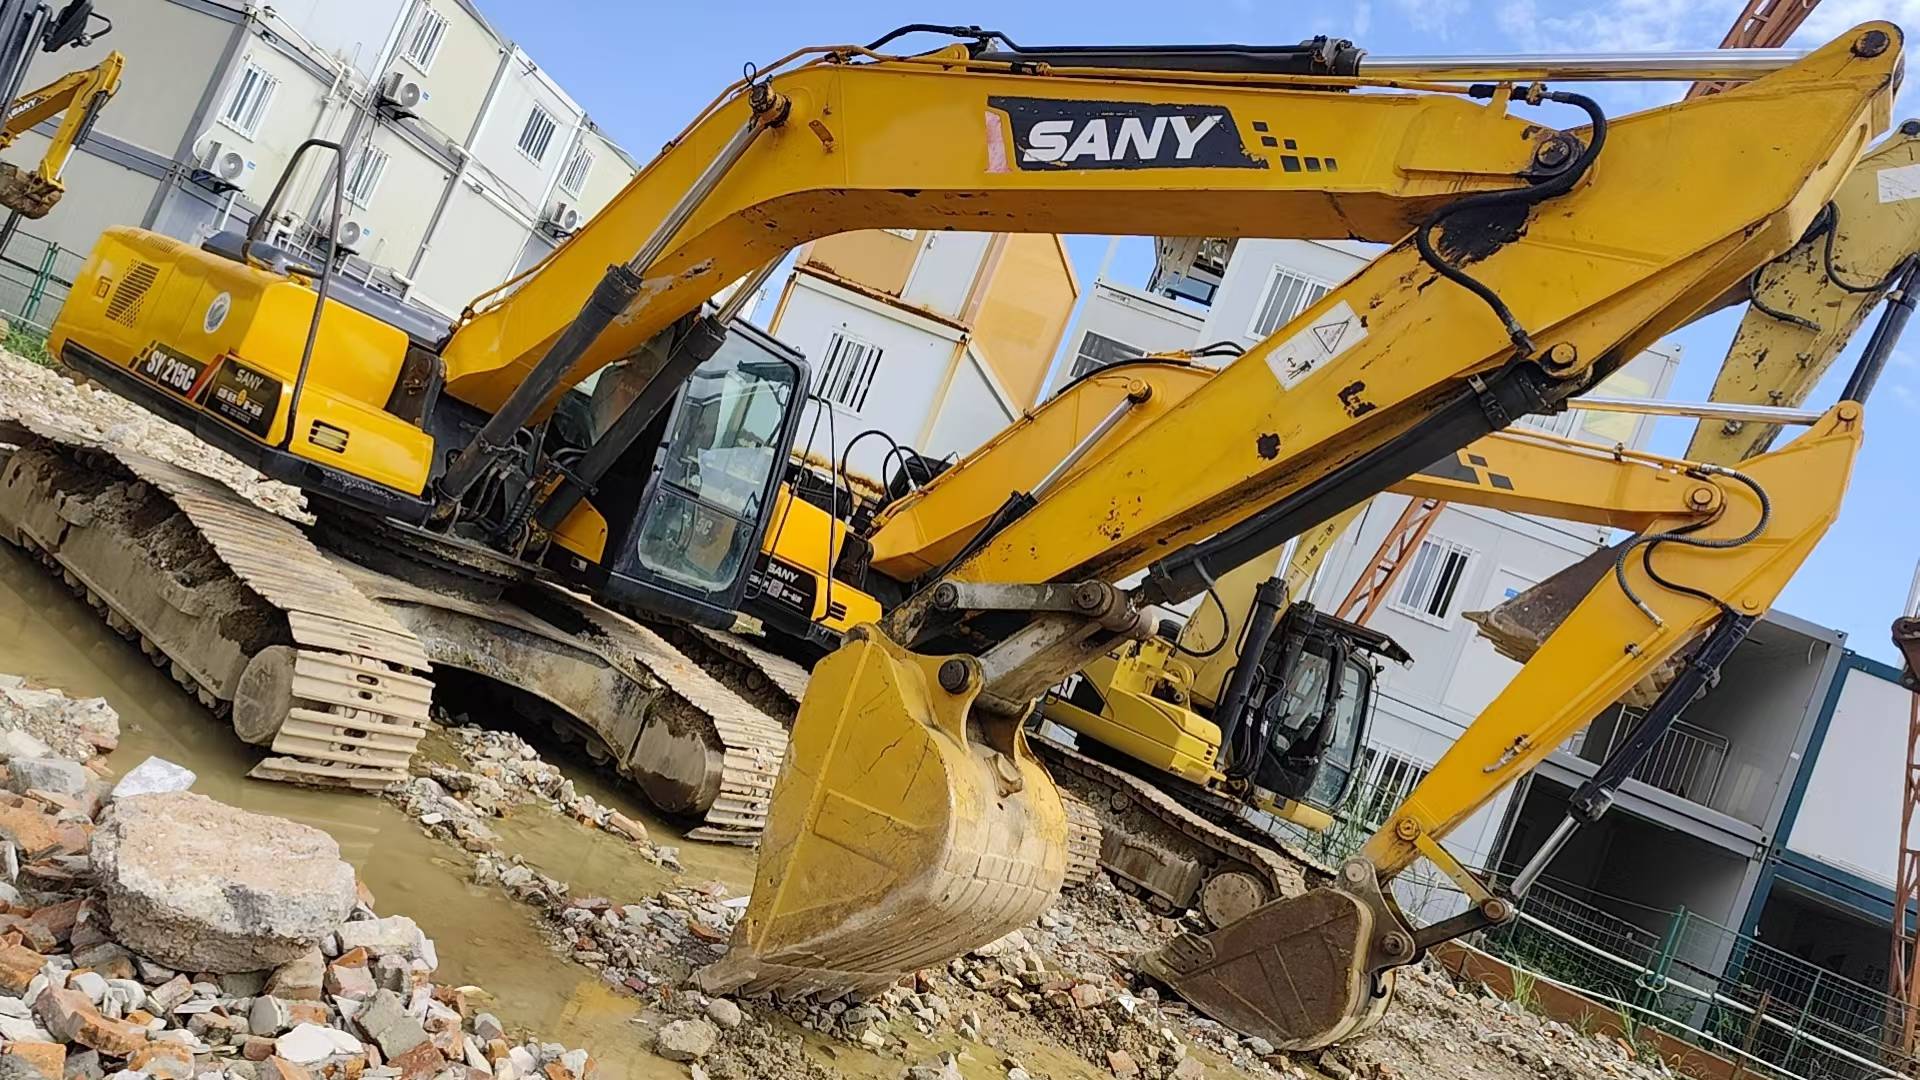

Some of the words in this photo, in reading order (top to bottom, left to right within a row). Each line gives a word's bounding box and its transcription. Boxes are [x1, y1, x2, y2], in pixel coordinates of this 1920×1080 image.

[1023, 115, 1223, 162] SANY
[161, 358, 196, 391] 215C
[235, 368, 264, 391] SANY
[767, 563, 799, 583] SANY
